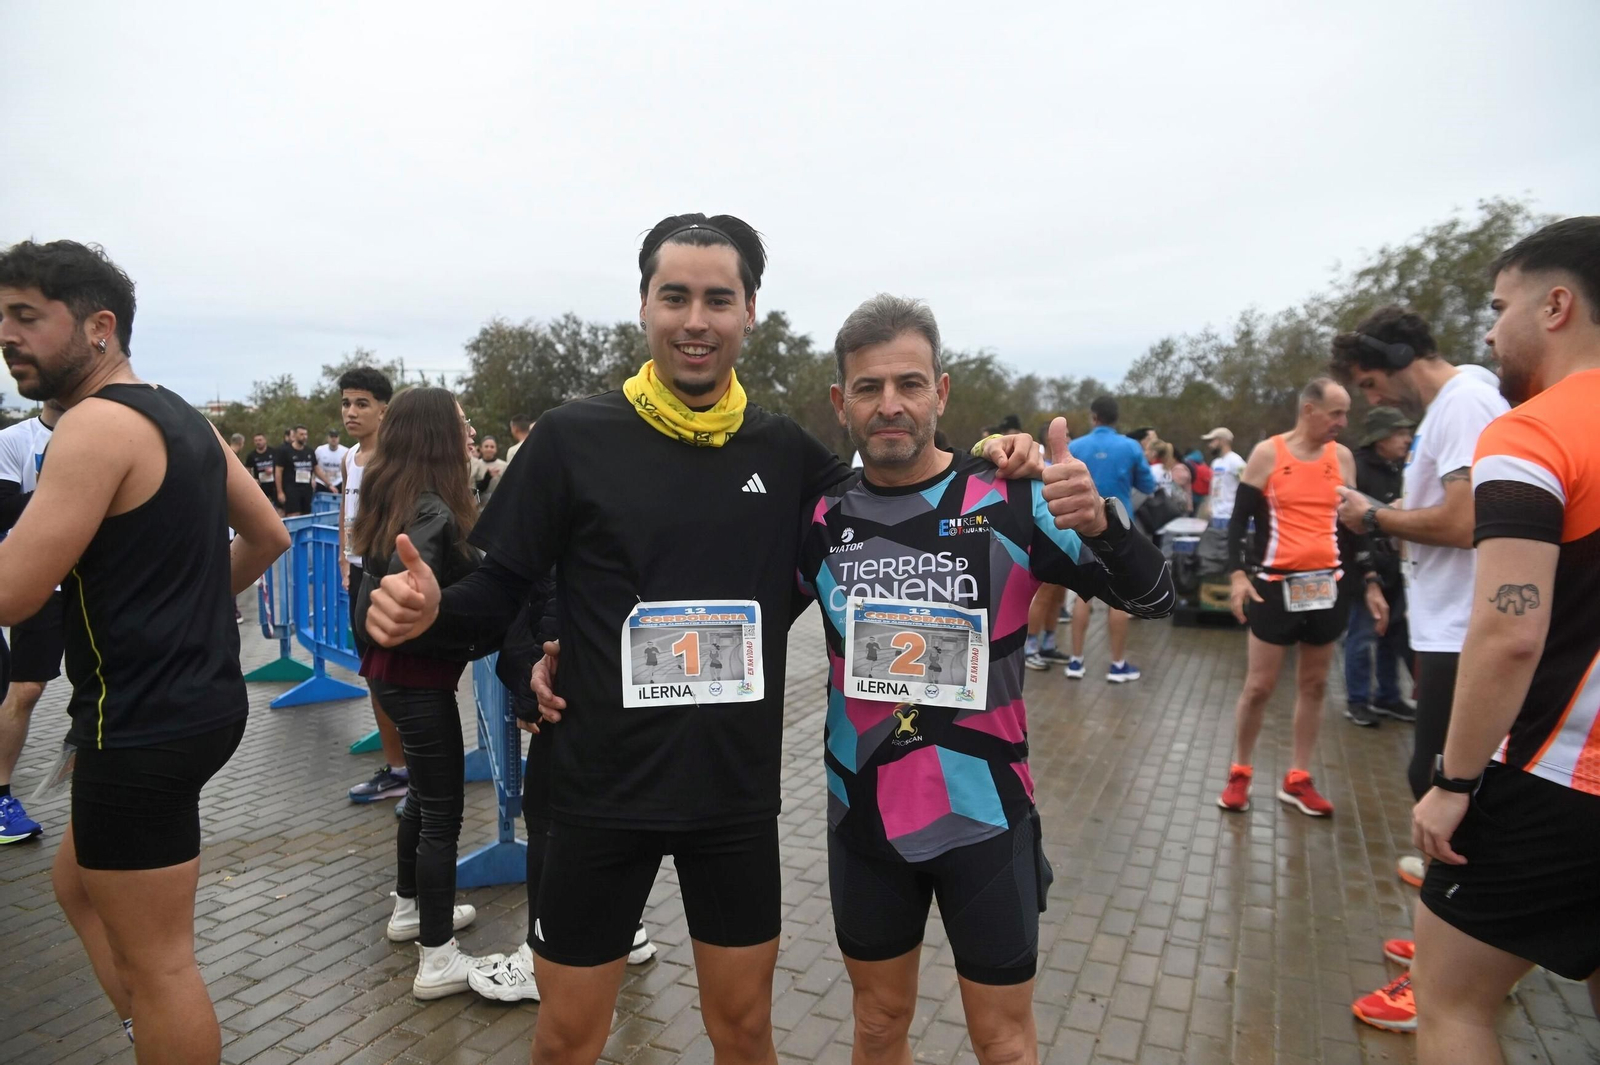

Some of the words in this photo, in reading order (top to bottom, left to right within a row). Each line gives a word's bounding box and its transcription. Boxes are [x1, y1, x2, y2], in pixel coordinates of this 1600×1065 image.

[829, 542, 864, 553] VIATOR
[672, 631, 700, 677] 1
[888, 631, 926, 677] 2
[970, 647, 979, 674] NAVIDAD
[638, 685, 693, 700] iLERNA
[857, 680, 909, 696] iLERNA
